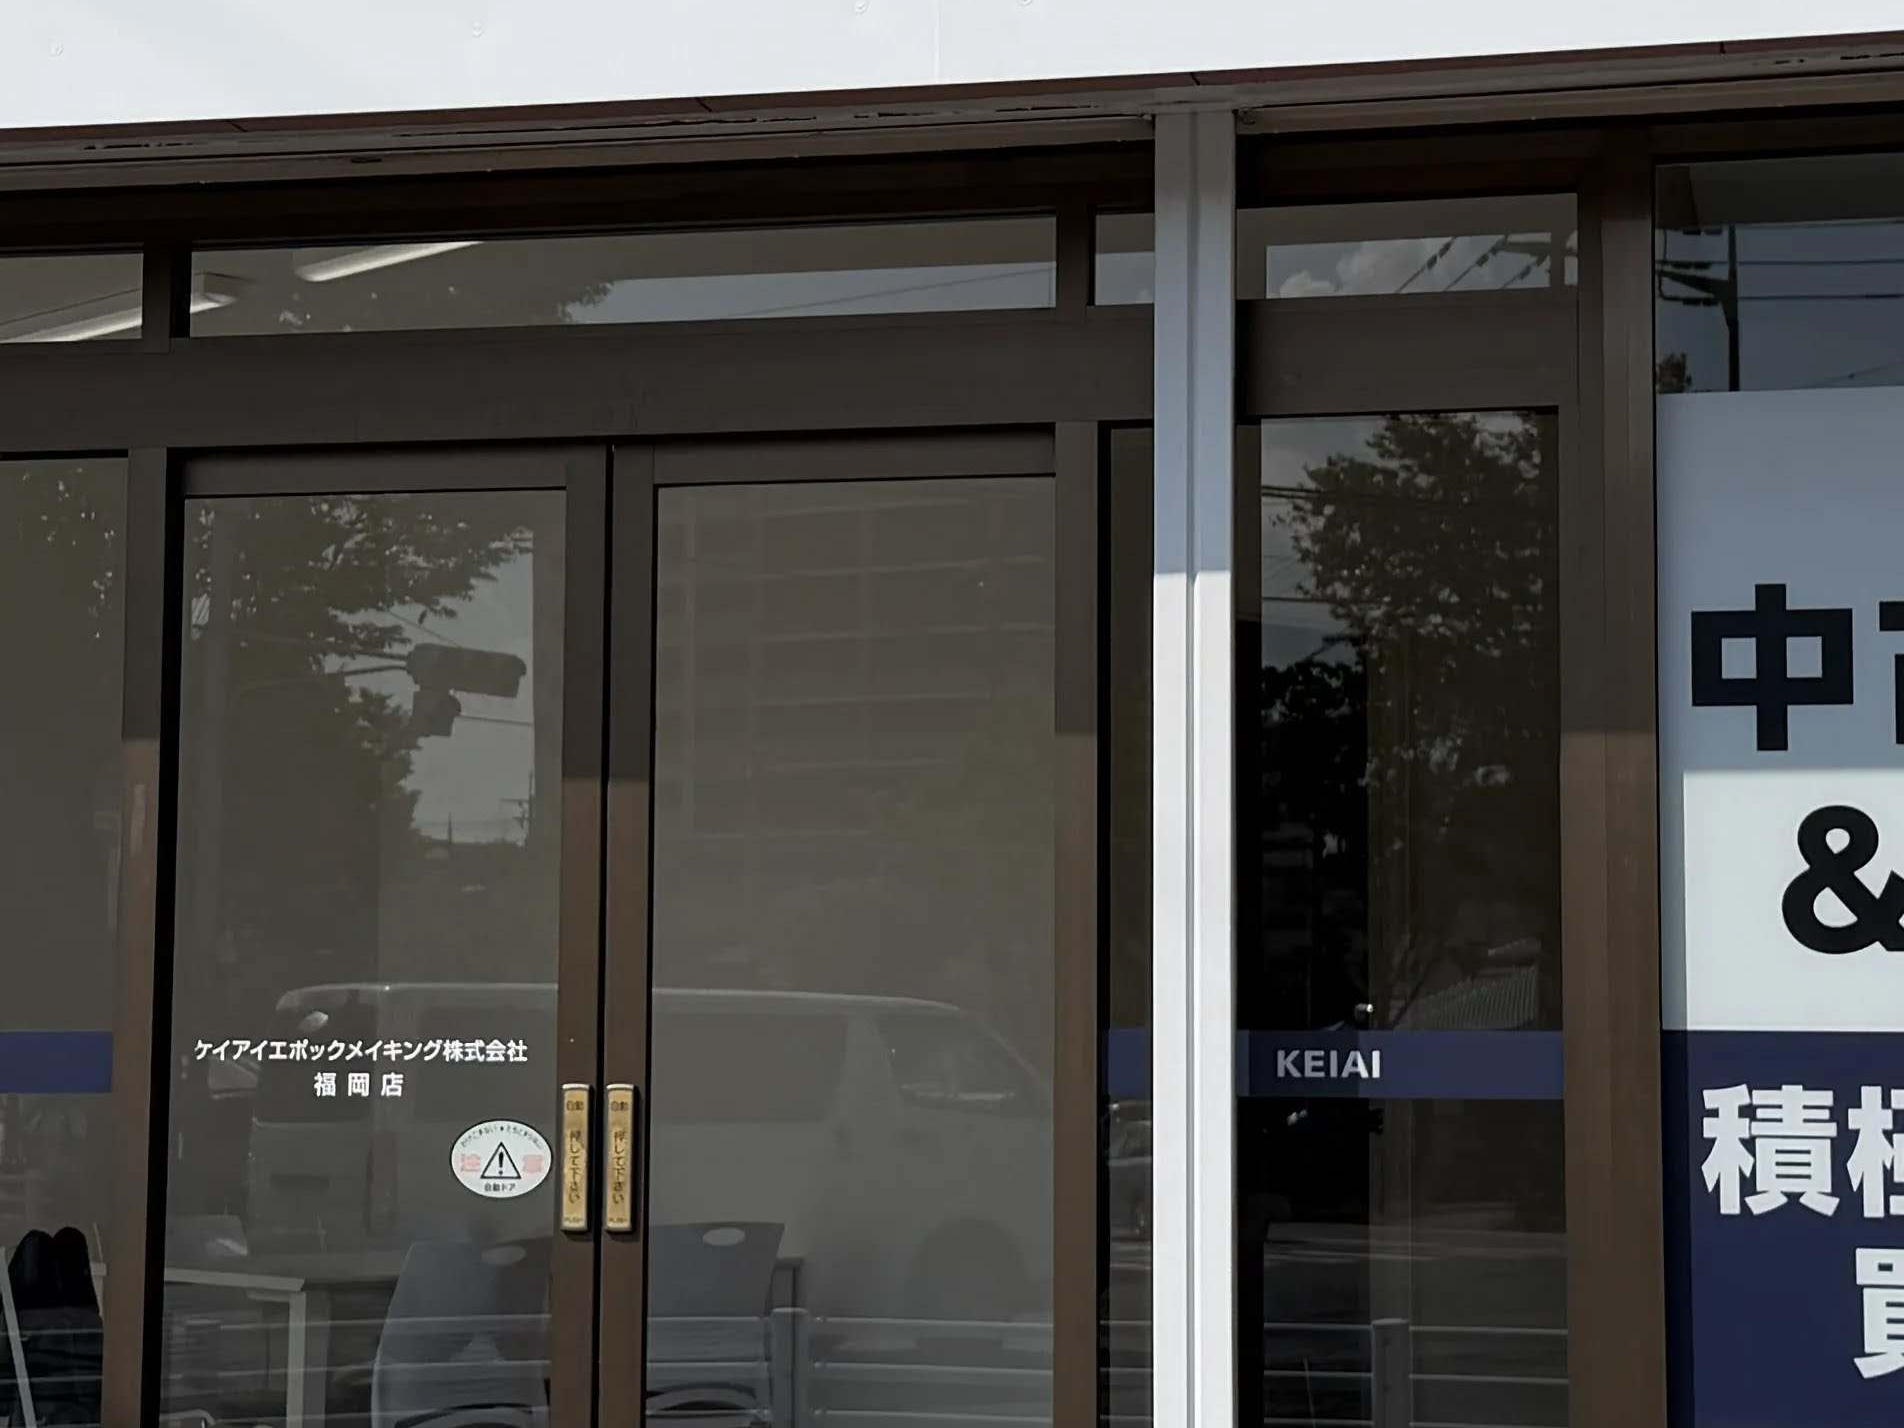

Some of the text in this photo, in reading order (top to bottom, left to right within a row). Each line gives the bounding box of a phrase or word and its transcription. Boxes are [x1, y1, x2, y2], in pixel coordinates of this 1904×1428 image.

[194, 1038, 528, 1063] ケイアイエポックメイキング株式会社
[1277, 1050, 1381, 1078] KEIAI
[314, 1072, 404, 1097] 福岡店
